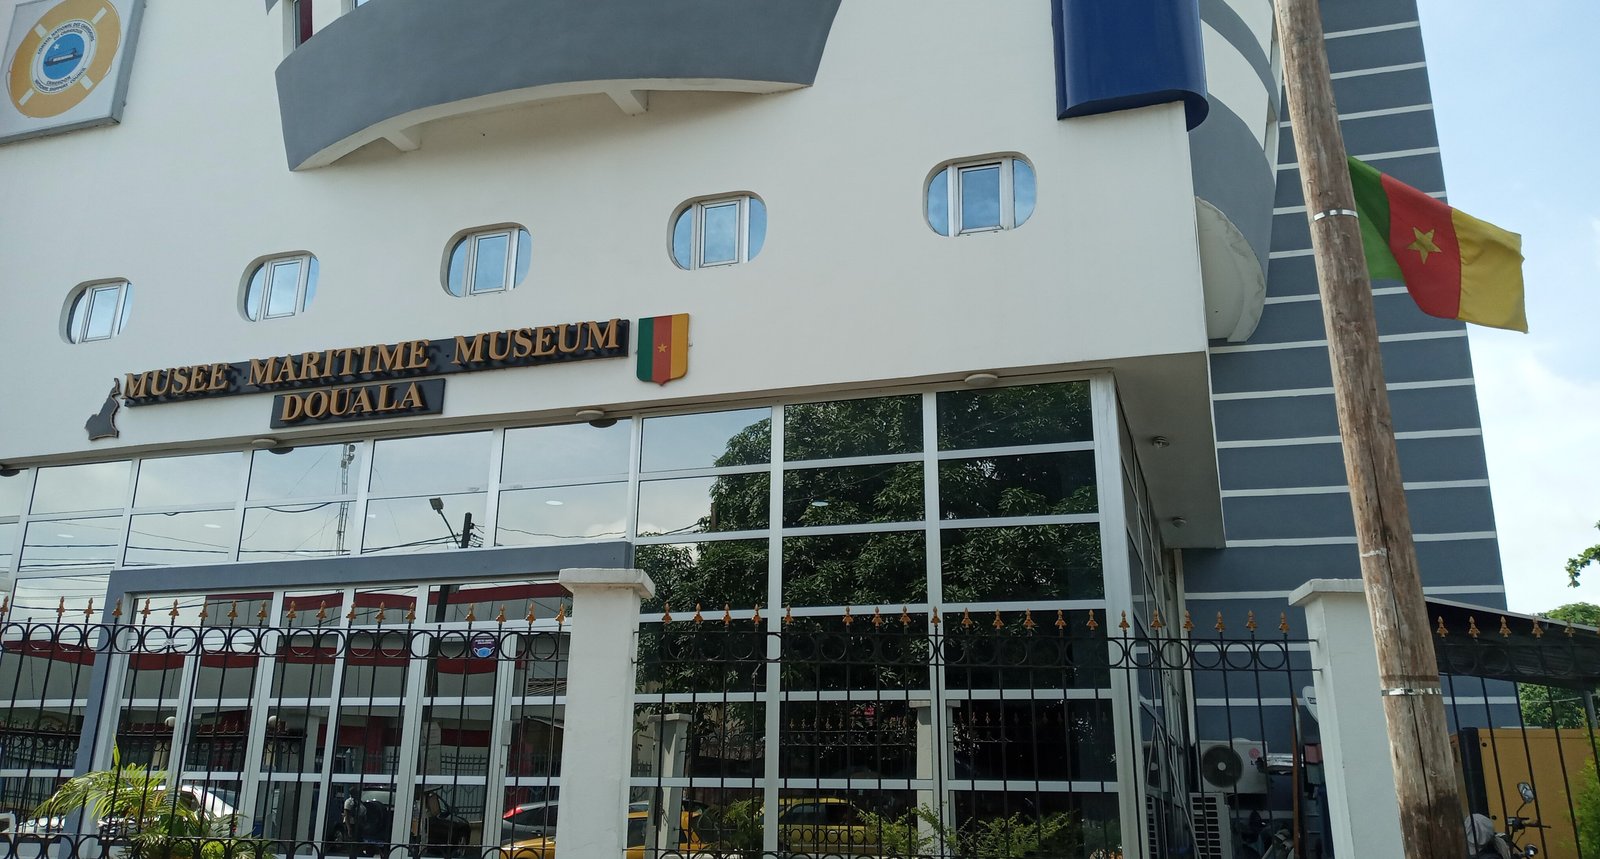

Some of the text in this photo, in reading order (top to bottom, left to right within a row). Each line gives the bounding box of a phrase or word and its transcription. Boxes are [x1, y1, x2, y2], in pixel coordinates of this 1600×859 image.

[122, 318, 621, 400] MUSEE MARITIME MUSEUM
[280, 381, 425, 421] DOUALA
